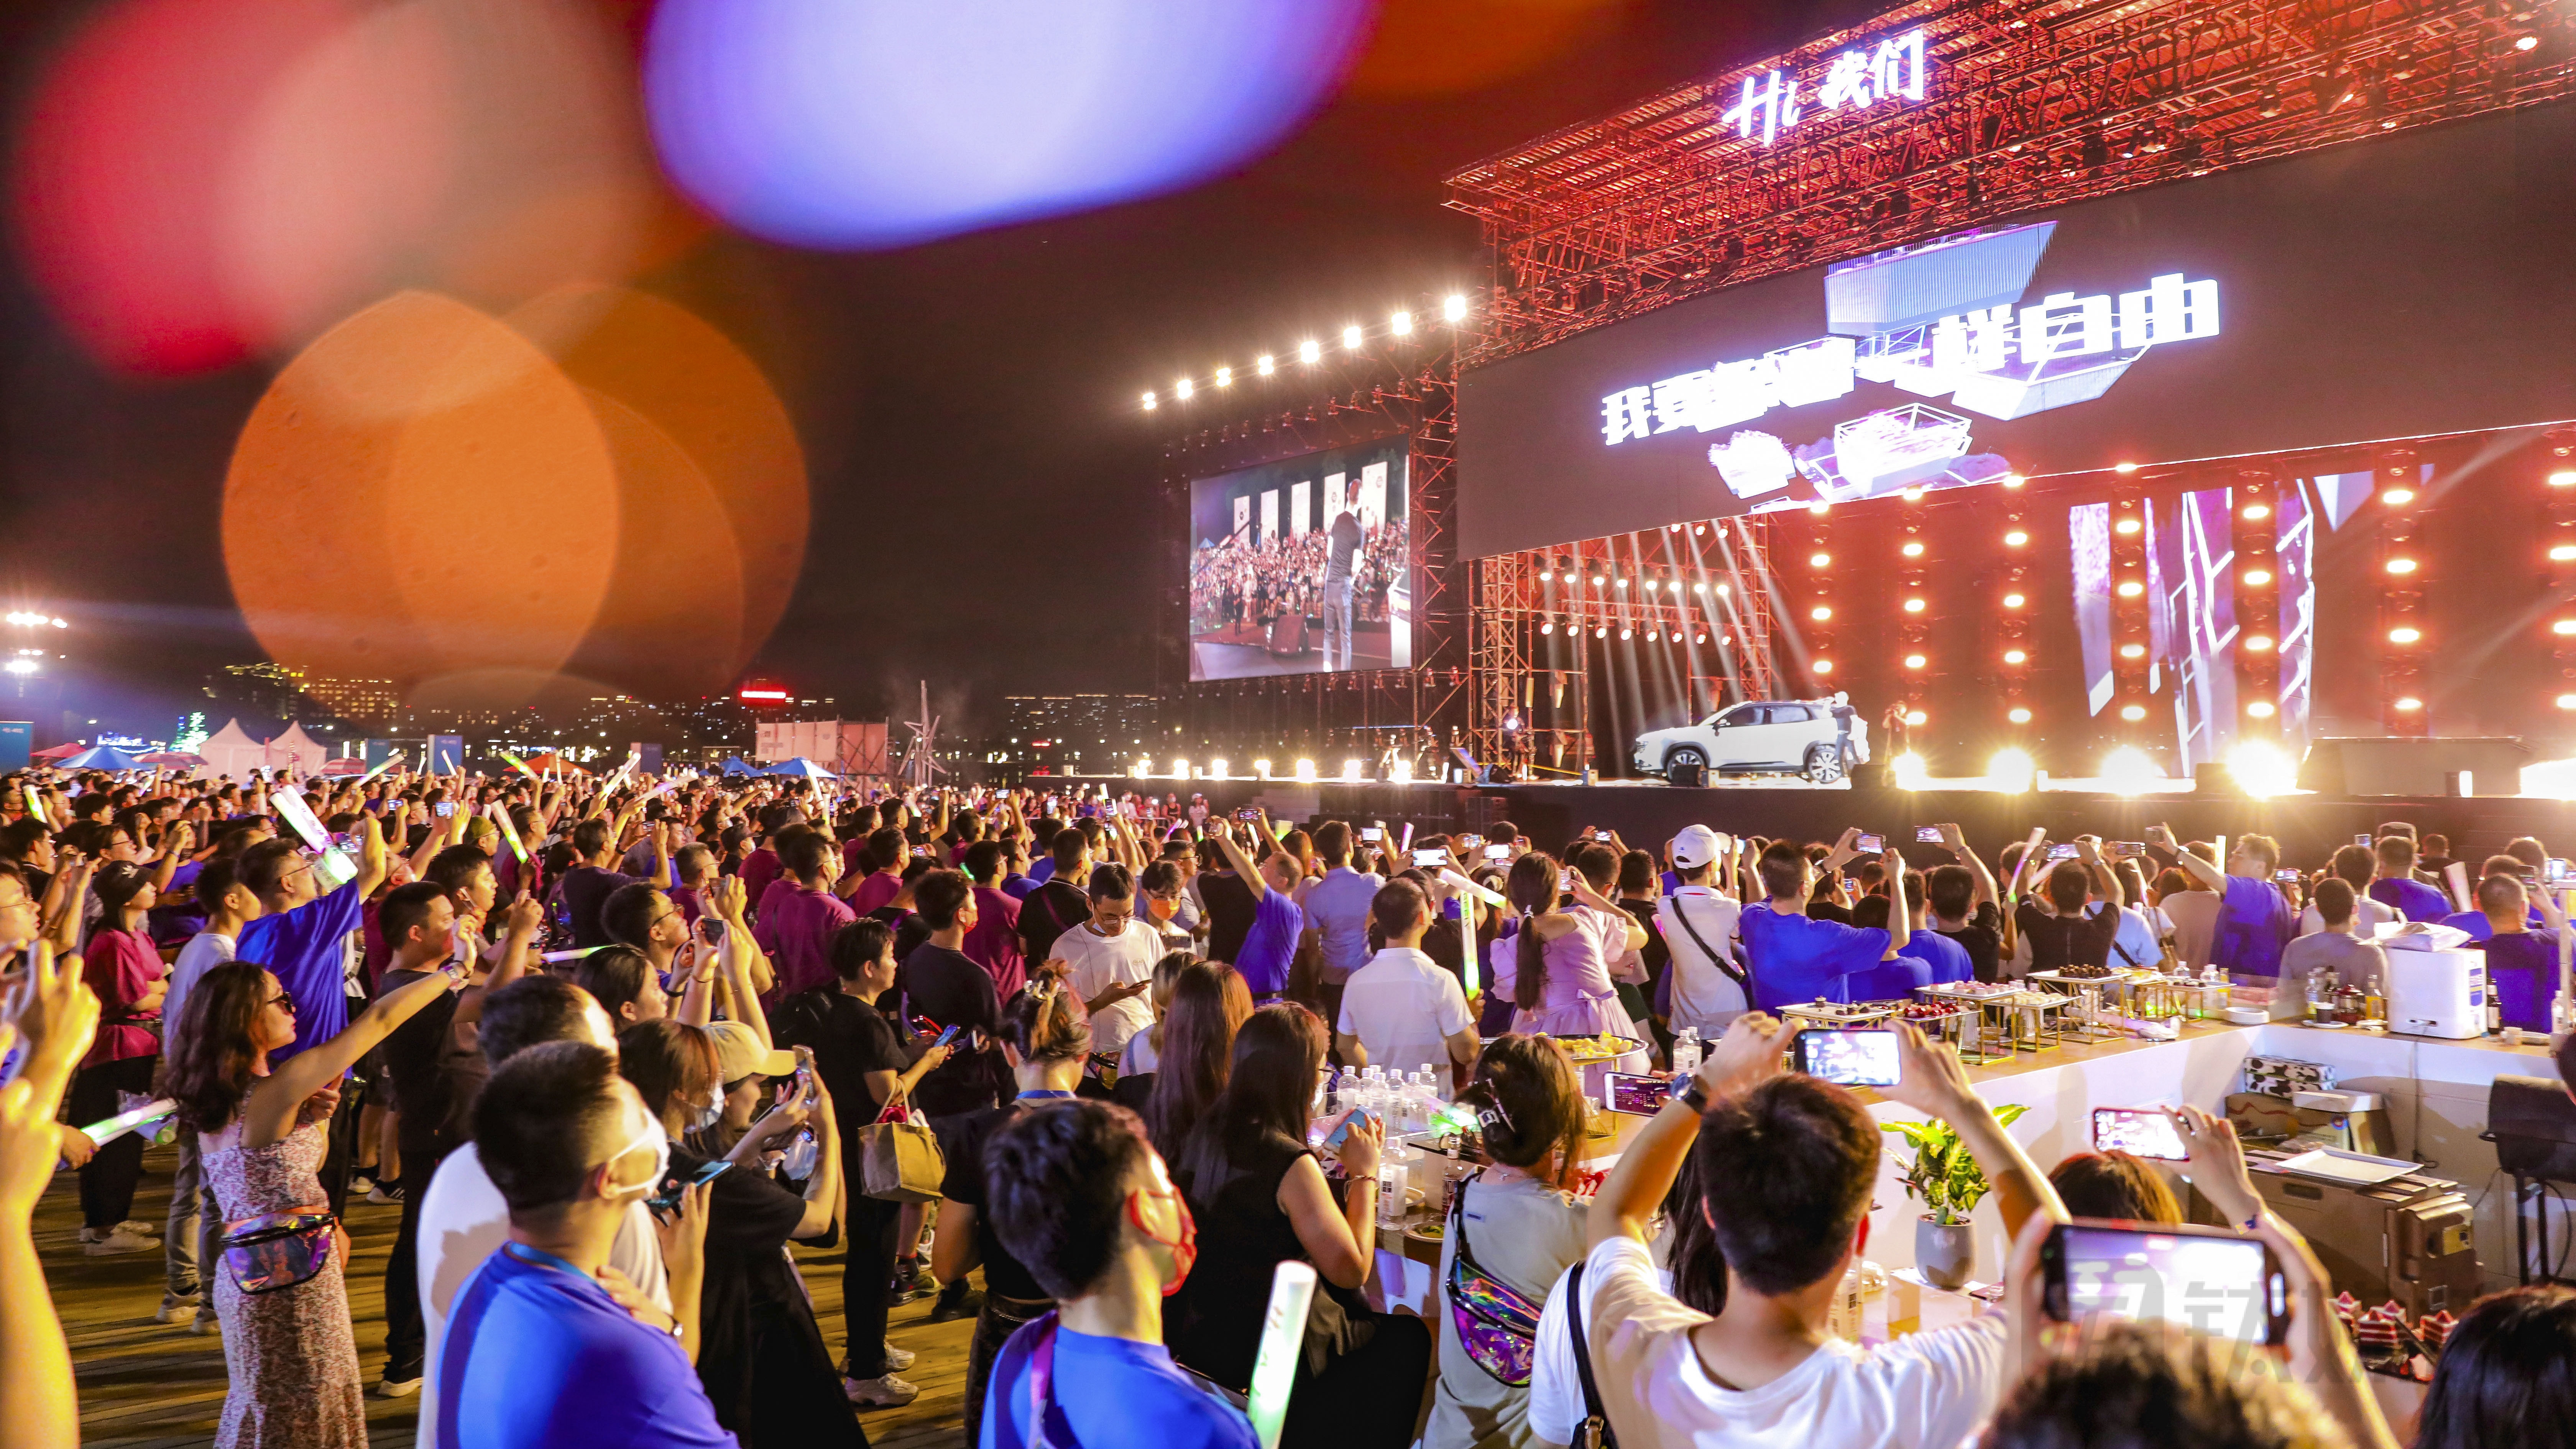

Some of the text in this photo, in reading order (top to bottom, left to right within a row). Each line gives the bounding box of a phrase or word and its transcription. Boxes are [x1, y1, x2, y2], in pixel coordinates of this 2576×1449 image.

[1722, 30, 1924, 147] Hi 我们
[1602, 272, 2220, 445] 我要一样自由
